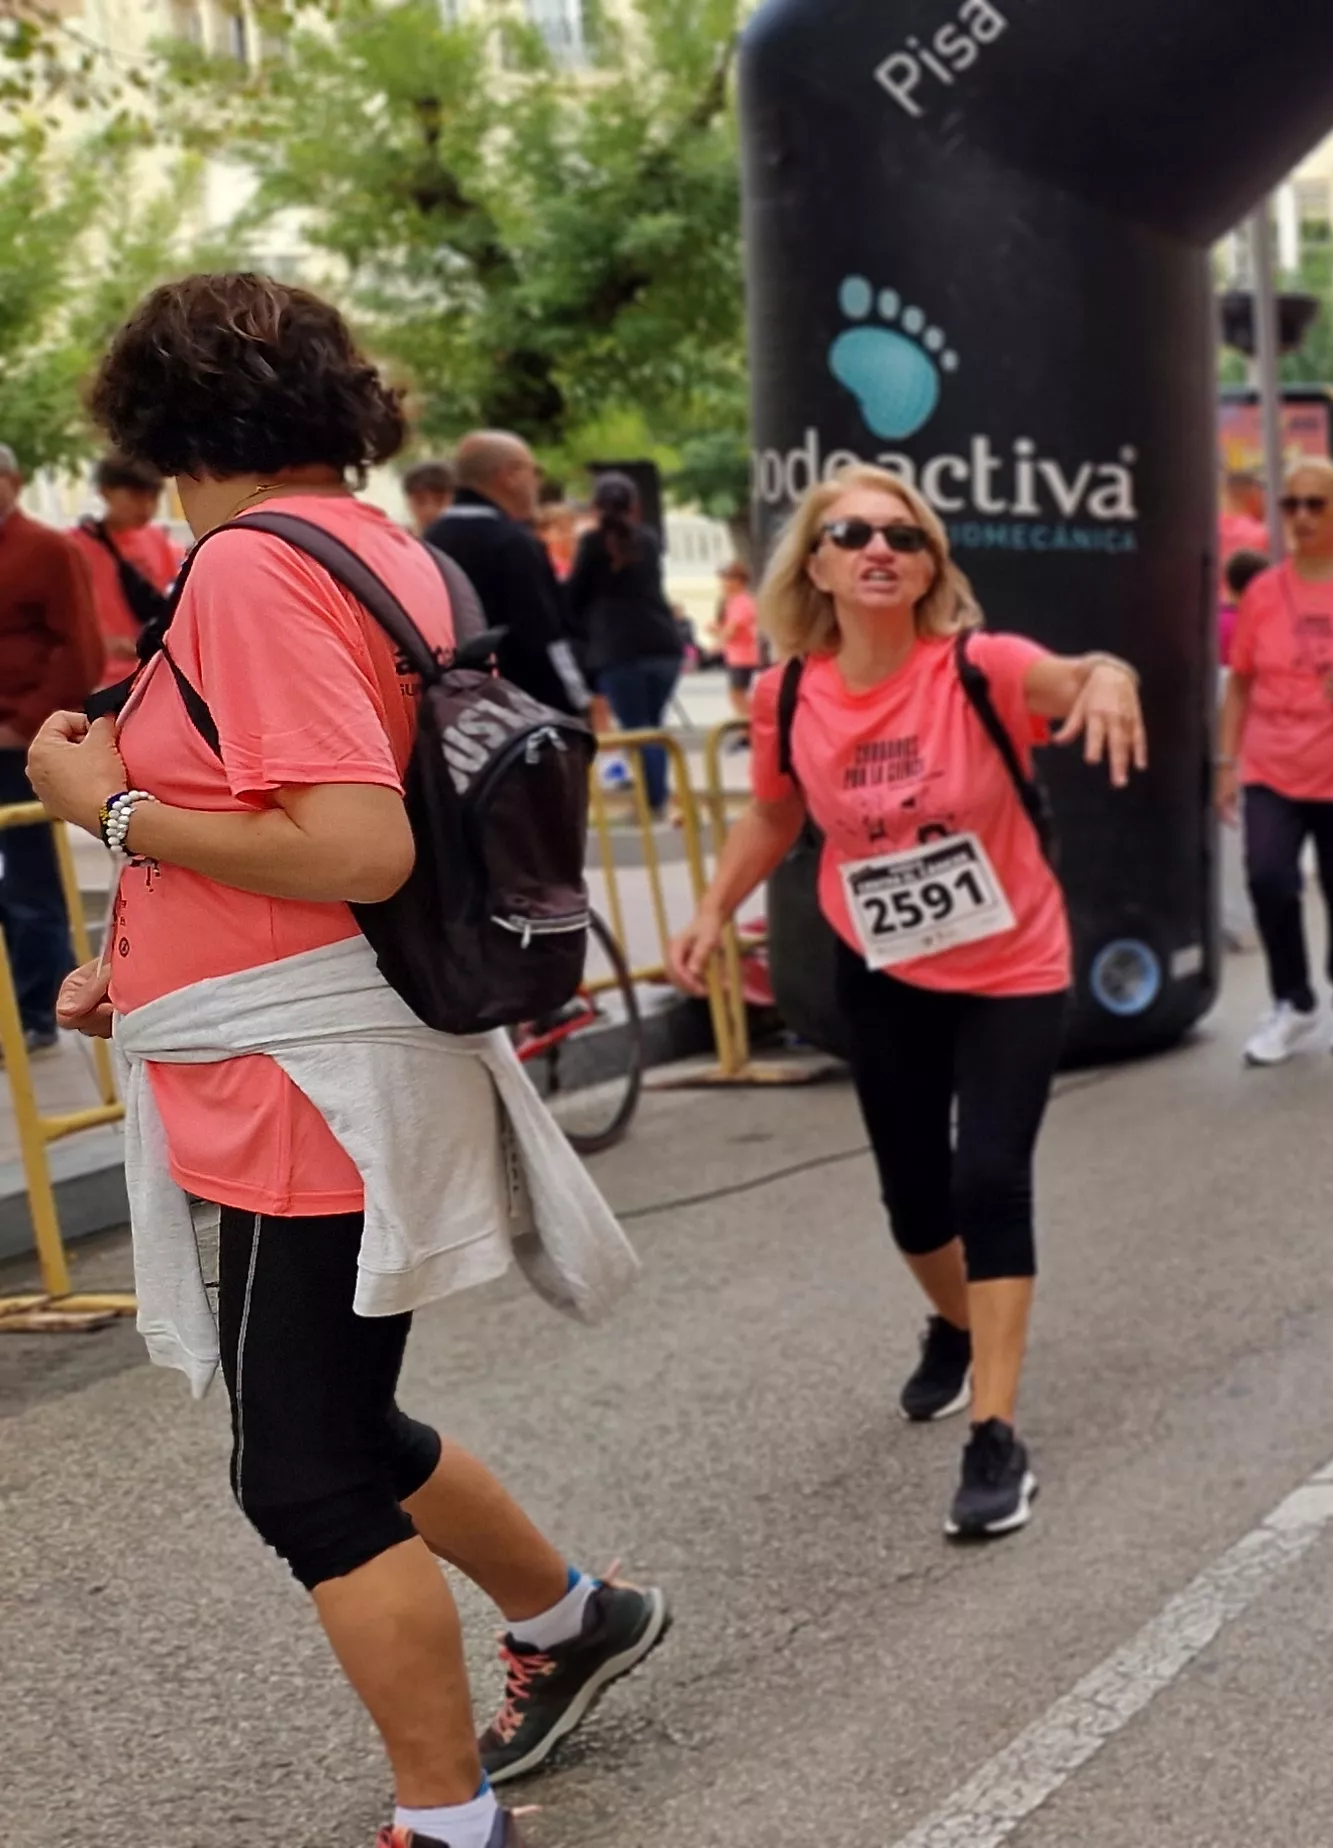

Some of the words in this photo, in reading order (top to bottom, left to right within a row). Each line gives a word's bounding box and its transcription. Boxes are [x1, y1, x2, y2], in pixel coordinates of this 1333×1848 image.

[874, 0, 1009, 117] Pisa
[950, 521, 1138, 552] IOMECÁNICA
[862, 868, 987, 936] 2591
